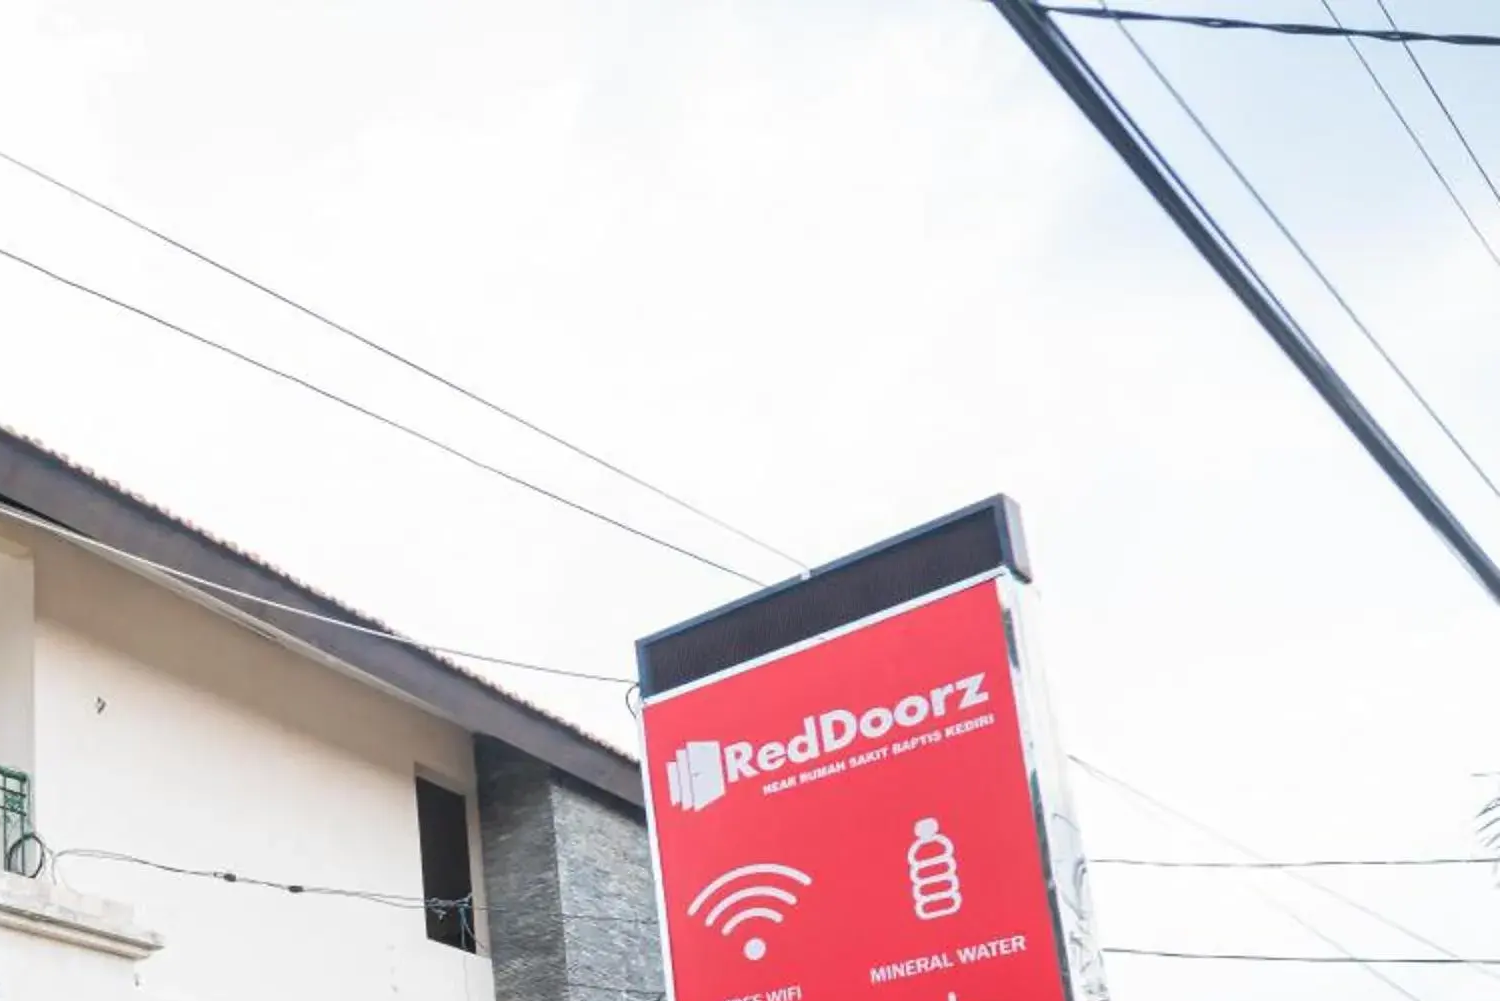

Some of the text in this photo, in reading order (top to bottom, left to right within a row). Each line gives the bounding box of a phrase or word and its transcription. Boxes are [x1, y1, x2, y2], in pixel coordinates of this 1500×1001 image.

[723, 672, 990, 783] RedDoorz
[762, 713, 996, 796] NEAR RUMAH SAKIT BAPTIS KEDIRI
[869, 935, 1028, 984] MINERAL WATER
